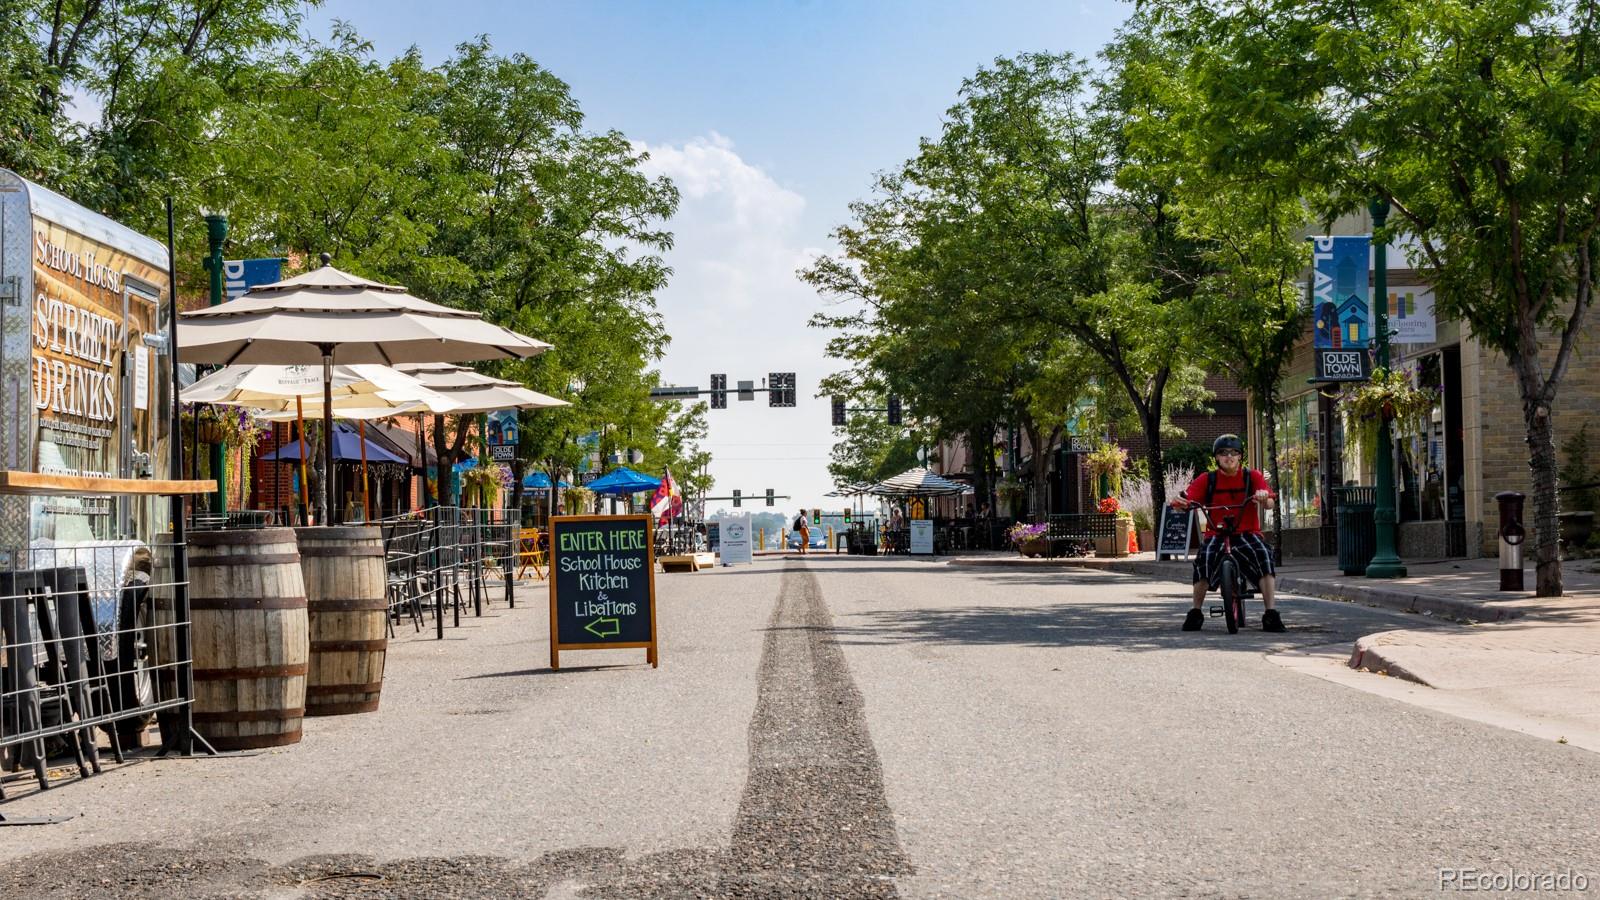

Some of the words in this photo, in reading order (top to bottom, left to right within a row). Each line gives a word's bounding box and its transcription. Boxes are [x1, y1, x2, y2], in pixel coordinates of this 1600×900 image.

[1314, 237, 1334, 303] PLAY
[36, 293, 115, 368] STREET
[1325, 363, 1360, 373] TOWN
[1327, 354, 1357, 364] OLDE
[35, 356, 116, 423] DRINKS
[560, 532, 607, 551] ENTER
[610, 530, 647, 550] HERE
[560, 554, 601, 572] School
[604, 554, 642, 570] House
[579, 572, 628, 591] Kitchen
[597, 591, 608, 601] &
[575, 600, 637, 617] Libations
